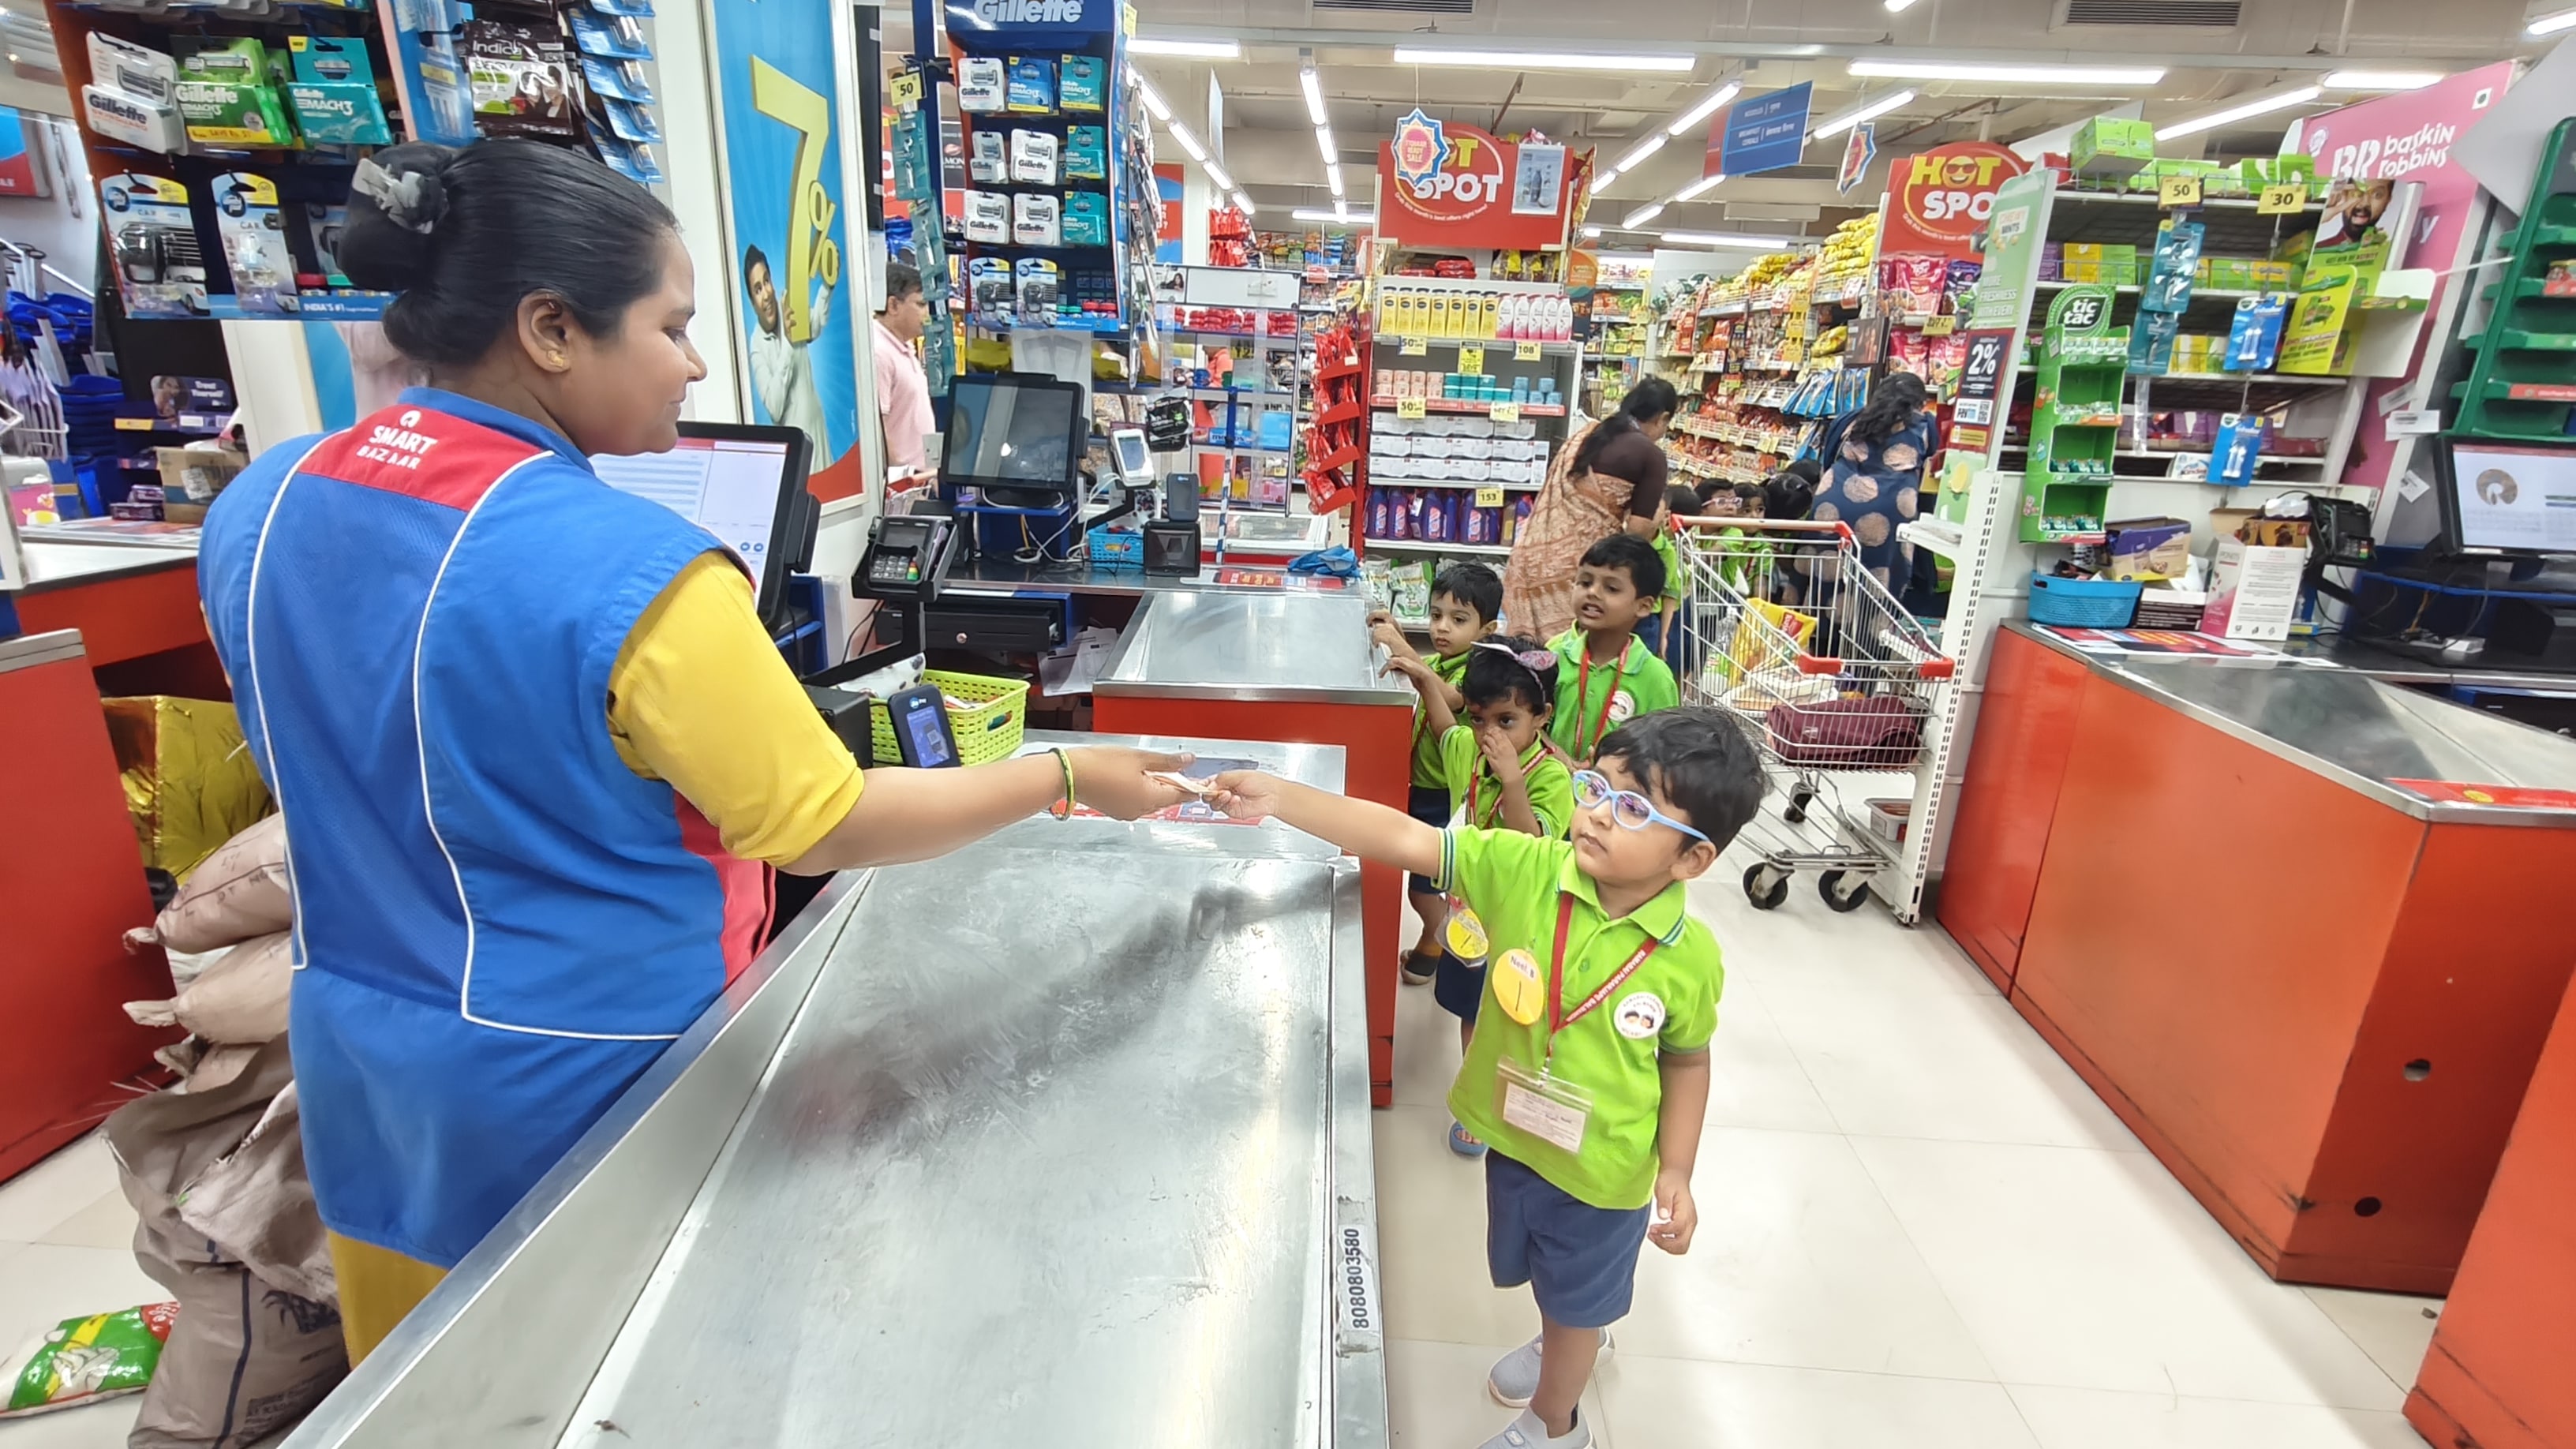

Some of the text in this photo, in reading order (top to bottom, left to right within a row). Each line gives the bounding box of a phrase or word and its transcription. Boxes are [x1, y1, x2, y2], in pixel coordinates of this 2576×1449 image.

[974, 0, 1082, 23] Gillette
[473, 39, 522, 55] Indica
[175, 83, 239, 103] Gillette
[961, 88, 990, 96] Gillette
[88, 93, 148, 125] Gillette
[1017, 159, 1047, 170] Gillette
[1413, 172, 1503, 202] SPOT
[969, 220, 1000, 231] Gillette
[1016, 223, 1046, 233] Gillette
[2072, 298, 2098, 315] tic
[2062, 309, 2094, 325] tac
[1968, 343, 1998, 376] 2%
[1401, 401, 1413, 412] 50
[368, 425, 439, 455] SMART
[356, 444, 421, 470] BAZAAR
[1481, 492, 1497, 502] 153
[1343, 1227, 1370, 1329] 8080803580
